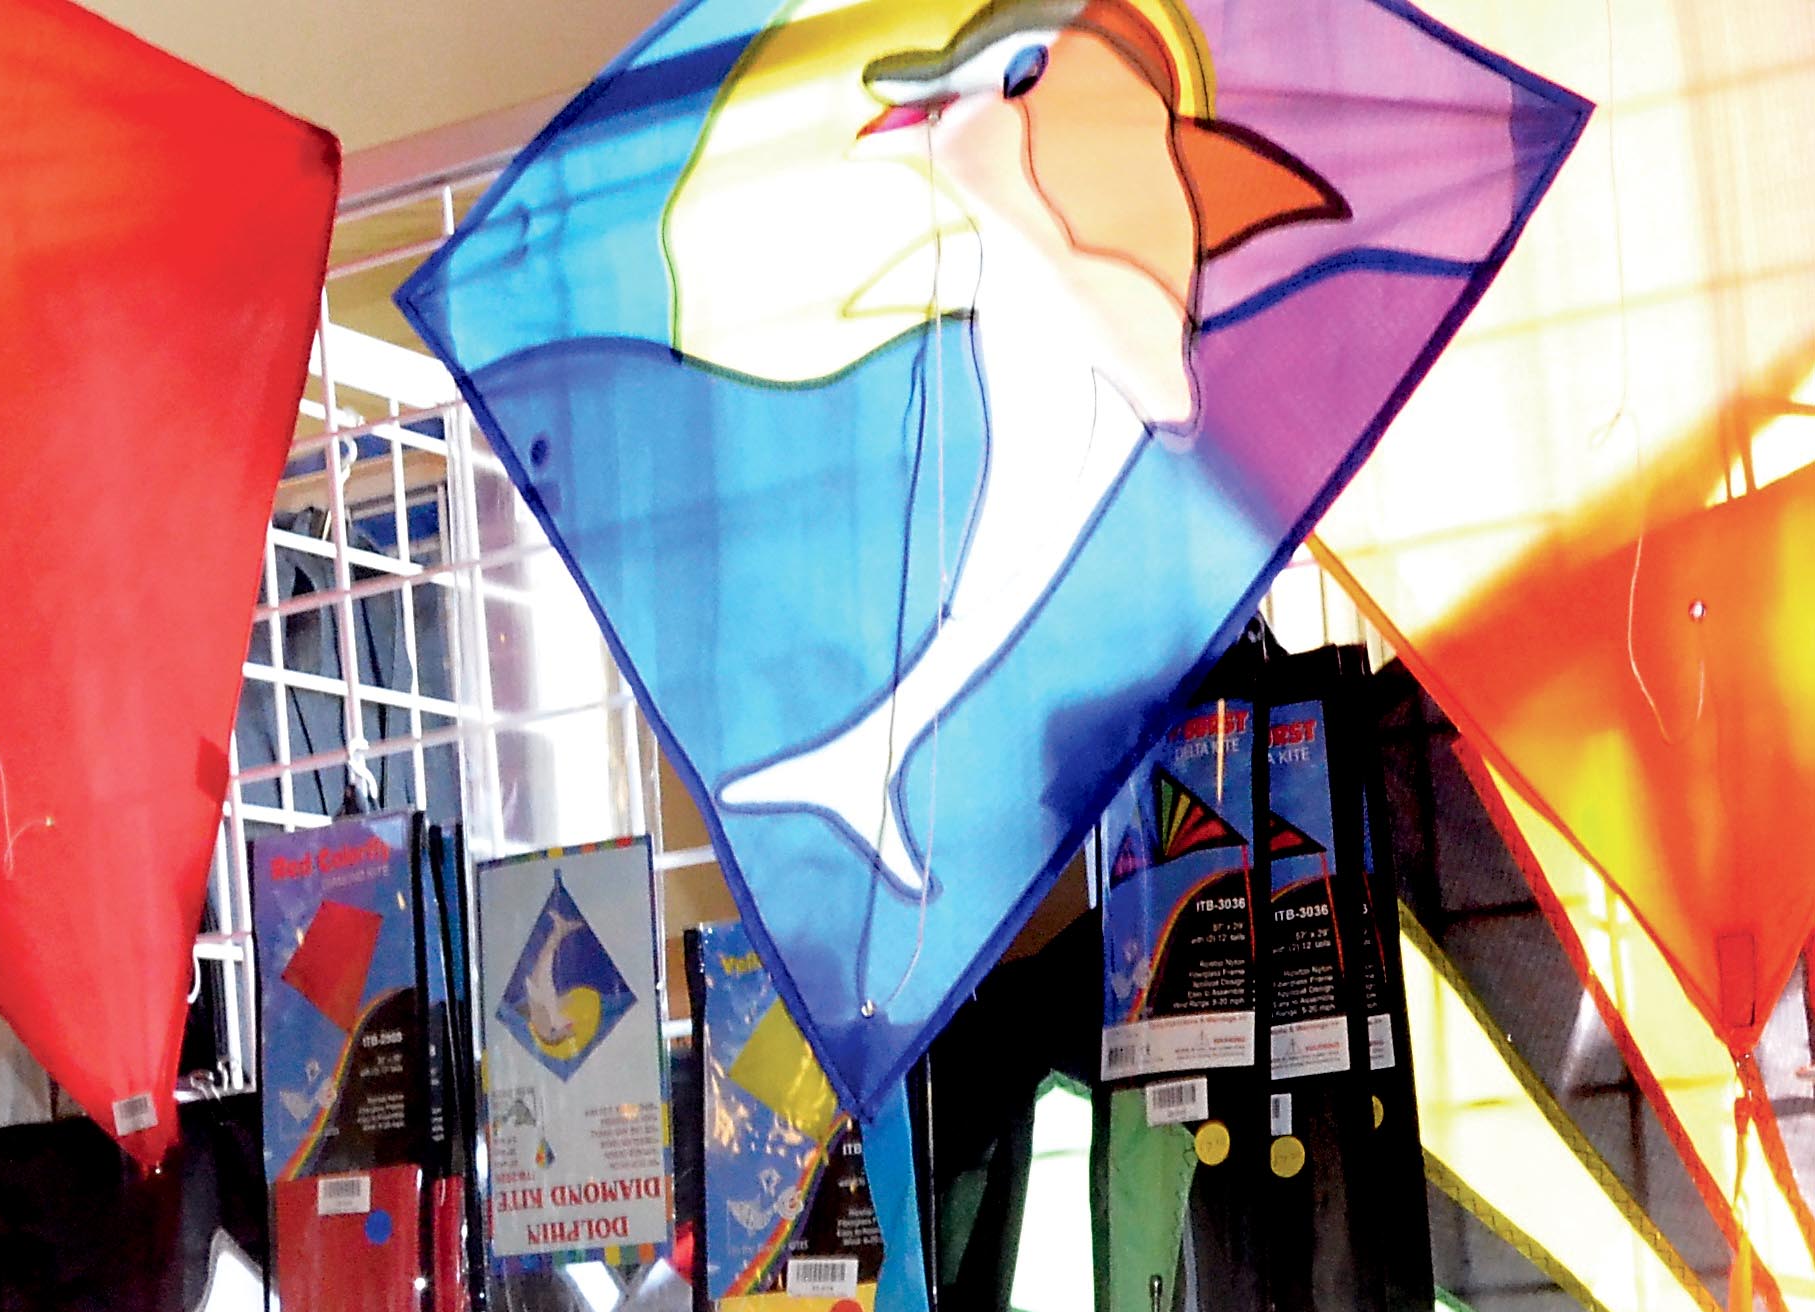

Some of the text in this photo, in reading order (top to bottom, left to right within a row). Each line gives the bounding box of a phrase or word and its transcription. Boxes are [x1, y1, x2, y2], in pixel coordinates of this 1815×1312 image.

[1168, 710, 1250, 741] BURST
[1210, 738, 1240, 754] KTE
[1279, 747, 1310, 764] KITE
[1196, 897, 1246, 913] ITB-3036
[1274, 903, 1329, 922] ITB-3036
[842, 1143, 863, 1156] ITB
[497, 1187, 544, 1213] KITE
[550, 1176, 662, 1208] DIAMOND
[527, 1215, 629, 1245] DOLPHIN
